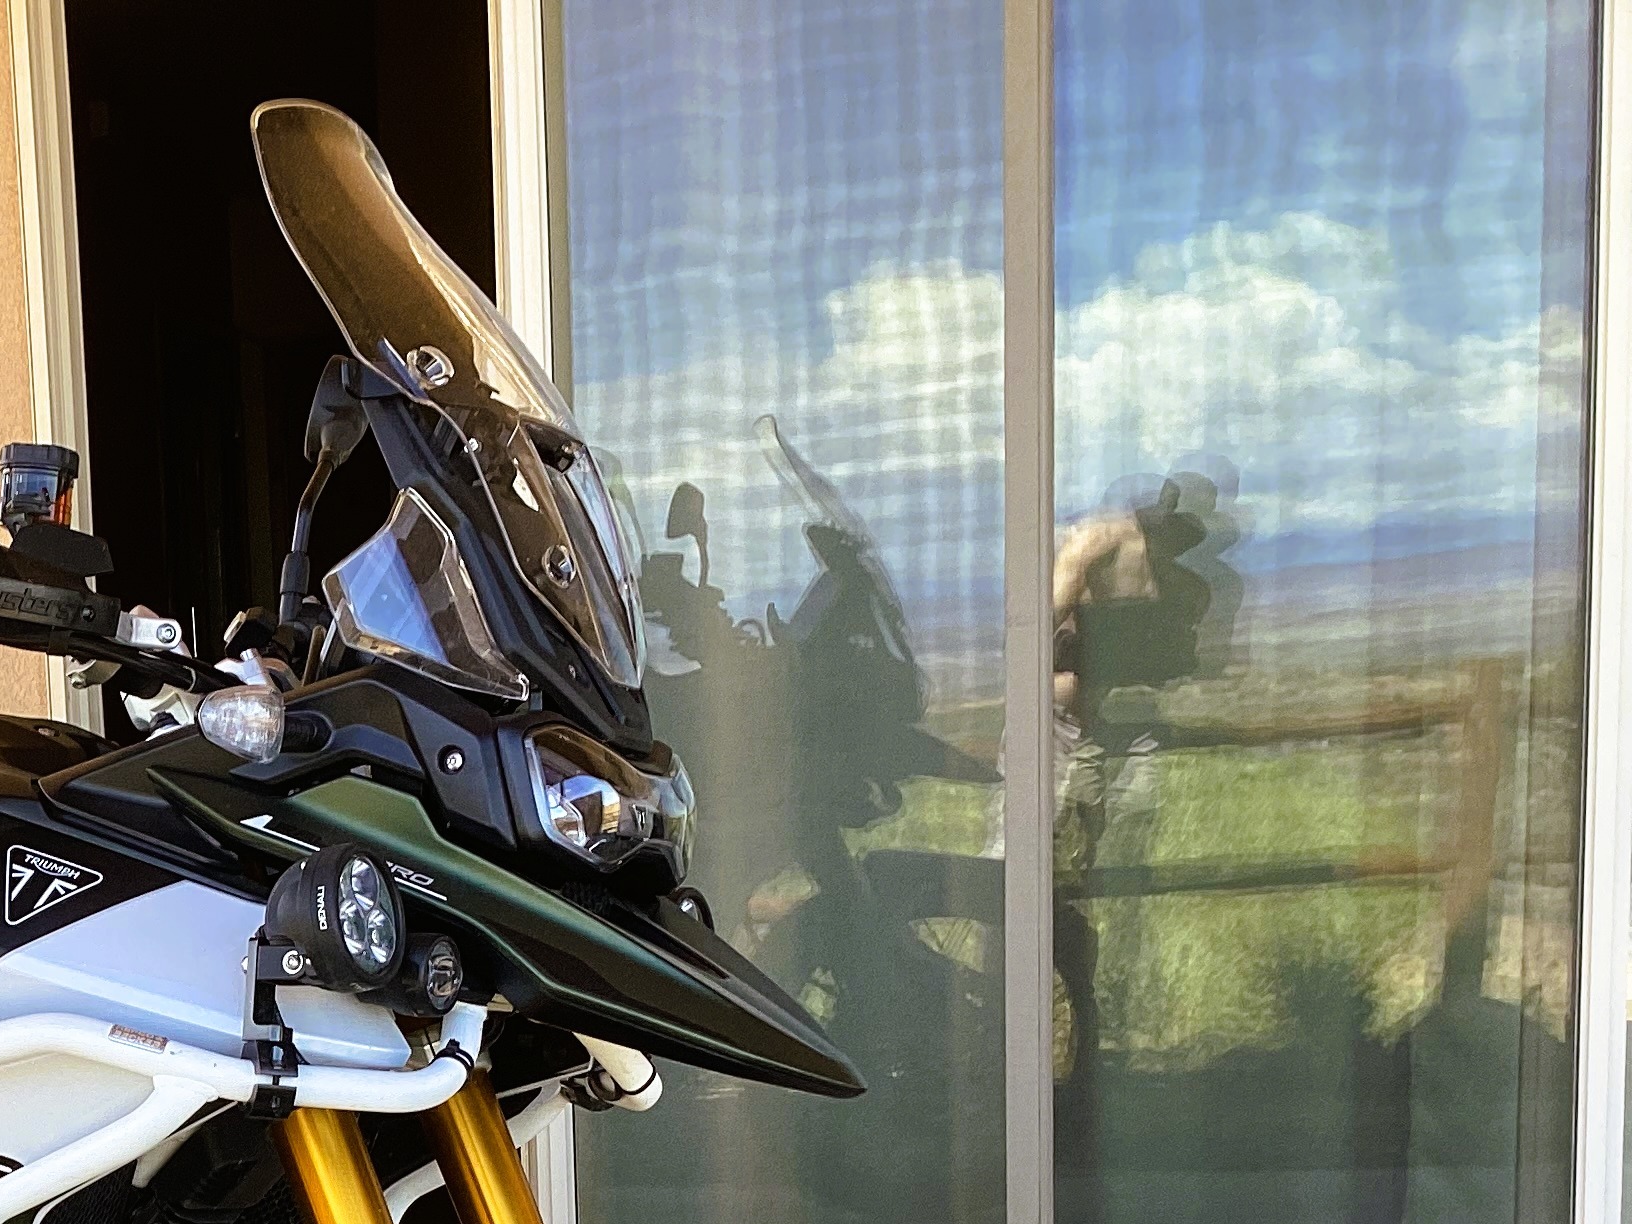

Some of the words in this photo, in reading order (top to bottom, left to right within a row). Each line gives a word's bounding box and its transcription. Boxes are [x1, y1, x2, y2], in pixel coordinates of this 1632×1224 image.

[24, 853, 81, 880] TRIUMPH
[385, 860, 435, 886] RO
[316, 885, 328, 931] DENALI
